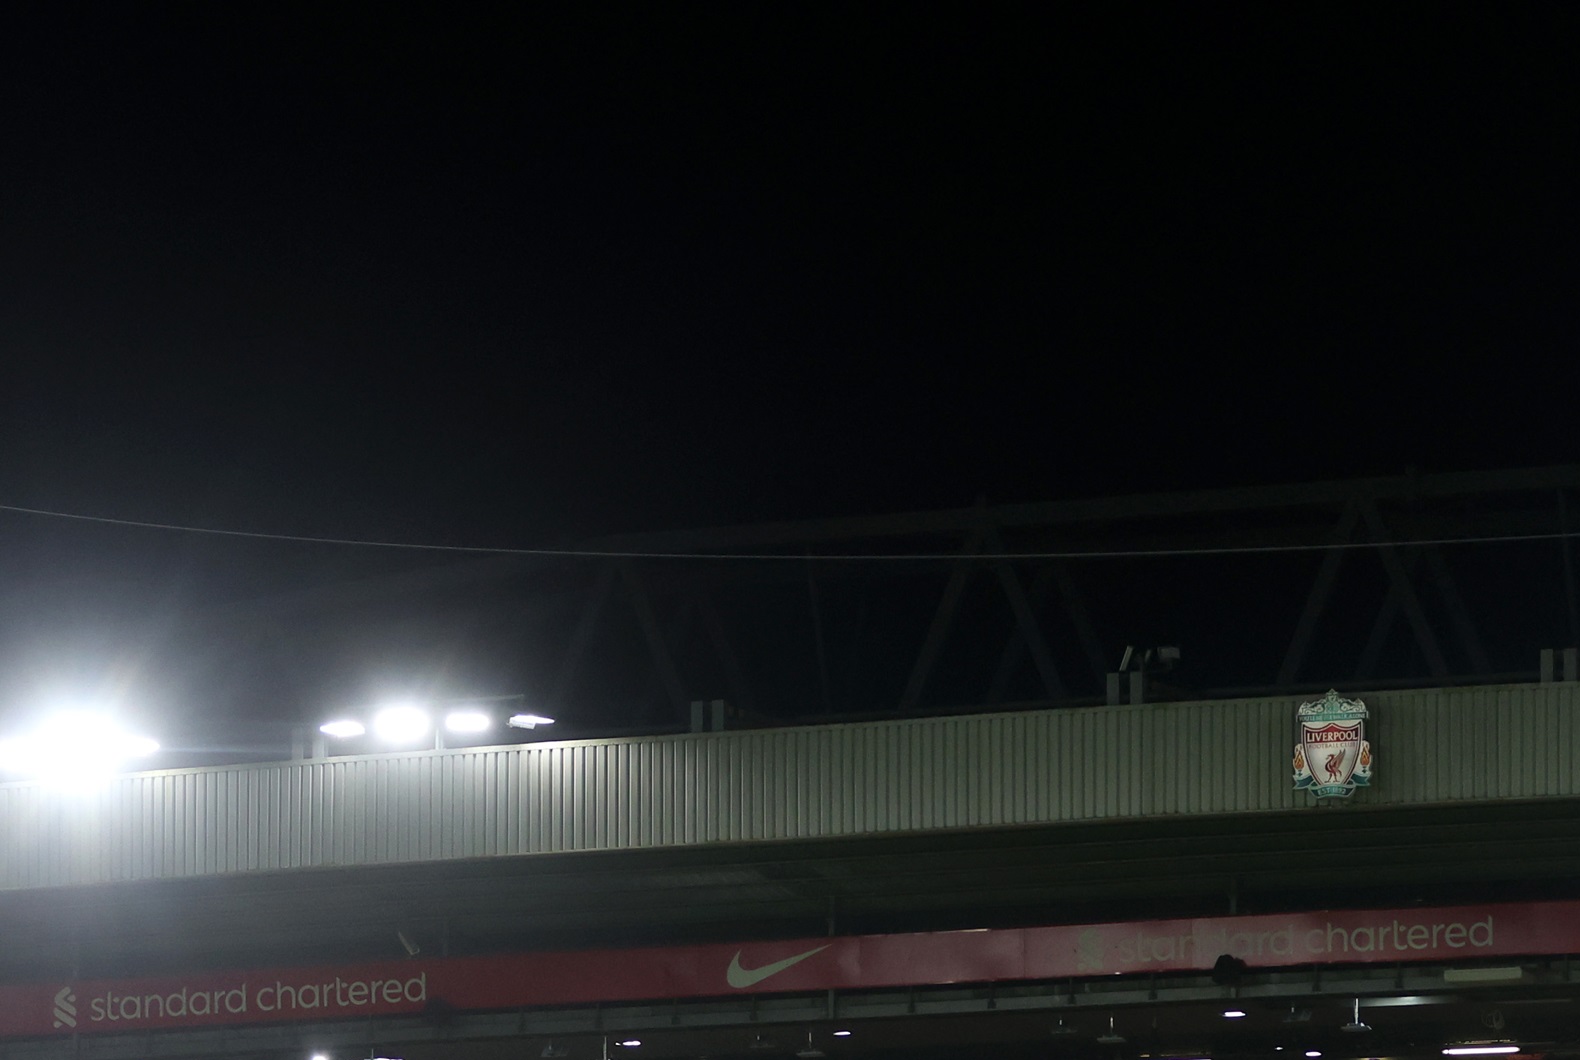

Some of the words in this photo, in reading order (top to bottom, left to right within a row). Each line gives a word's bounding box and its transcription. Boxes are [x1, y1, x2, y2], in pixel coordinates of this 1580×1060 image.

[1307, 730, 1358, 742] LIVERPOOL
[1119, 924, 1294, 964] standard
[1306, 915, 1494, 955] chartered
[90, 984, 247, 1021] standard
[256, 972, 427, 1011] chartered
